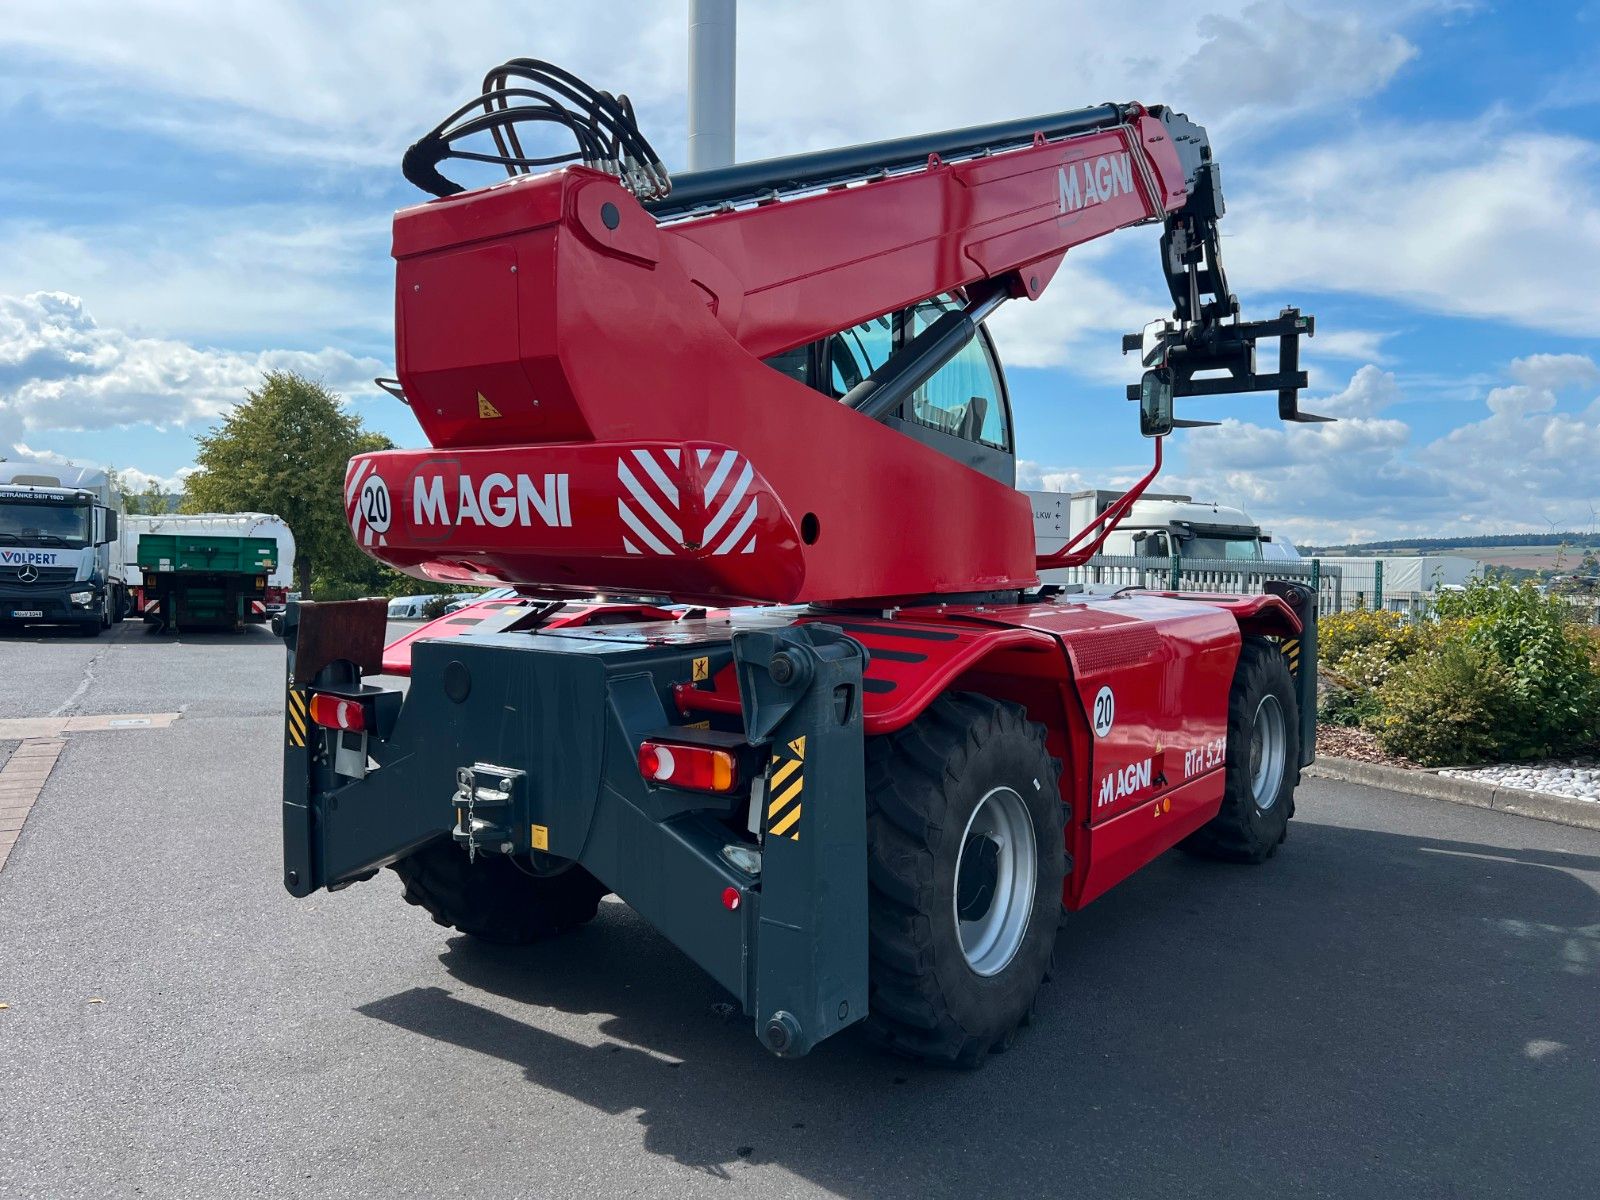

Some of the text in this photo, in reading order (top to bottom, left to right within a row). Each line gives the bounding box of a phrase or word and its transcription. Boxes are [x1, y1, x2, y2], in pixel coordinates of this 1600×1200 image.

[1058, 152, 1134, 214] MAGNI
[364, 485, 388, 523] 20
[413, 472, 573, 528] MAGNI
[1035, 511, 1052, 519] LKW
[1, 551, 57, 564] VOLPERT
[1096, 694, 1112, 729] 20
[1206, 736, 1227, 769] 5.21
[1097, 758, 1152, 807] MAGNI
